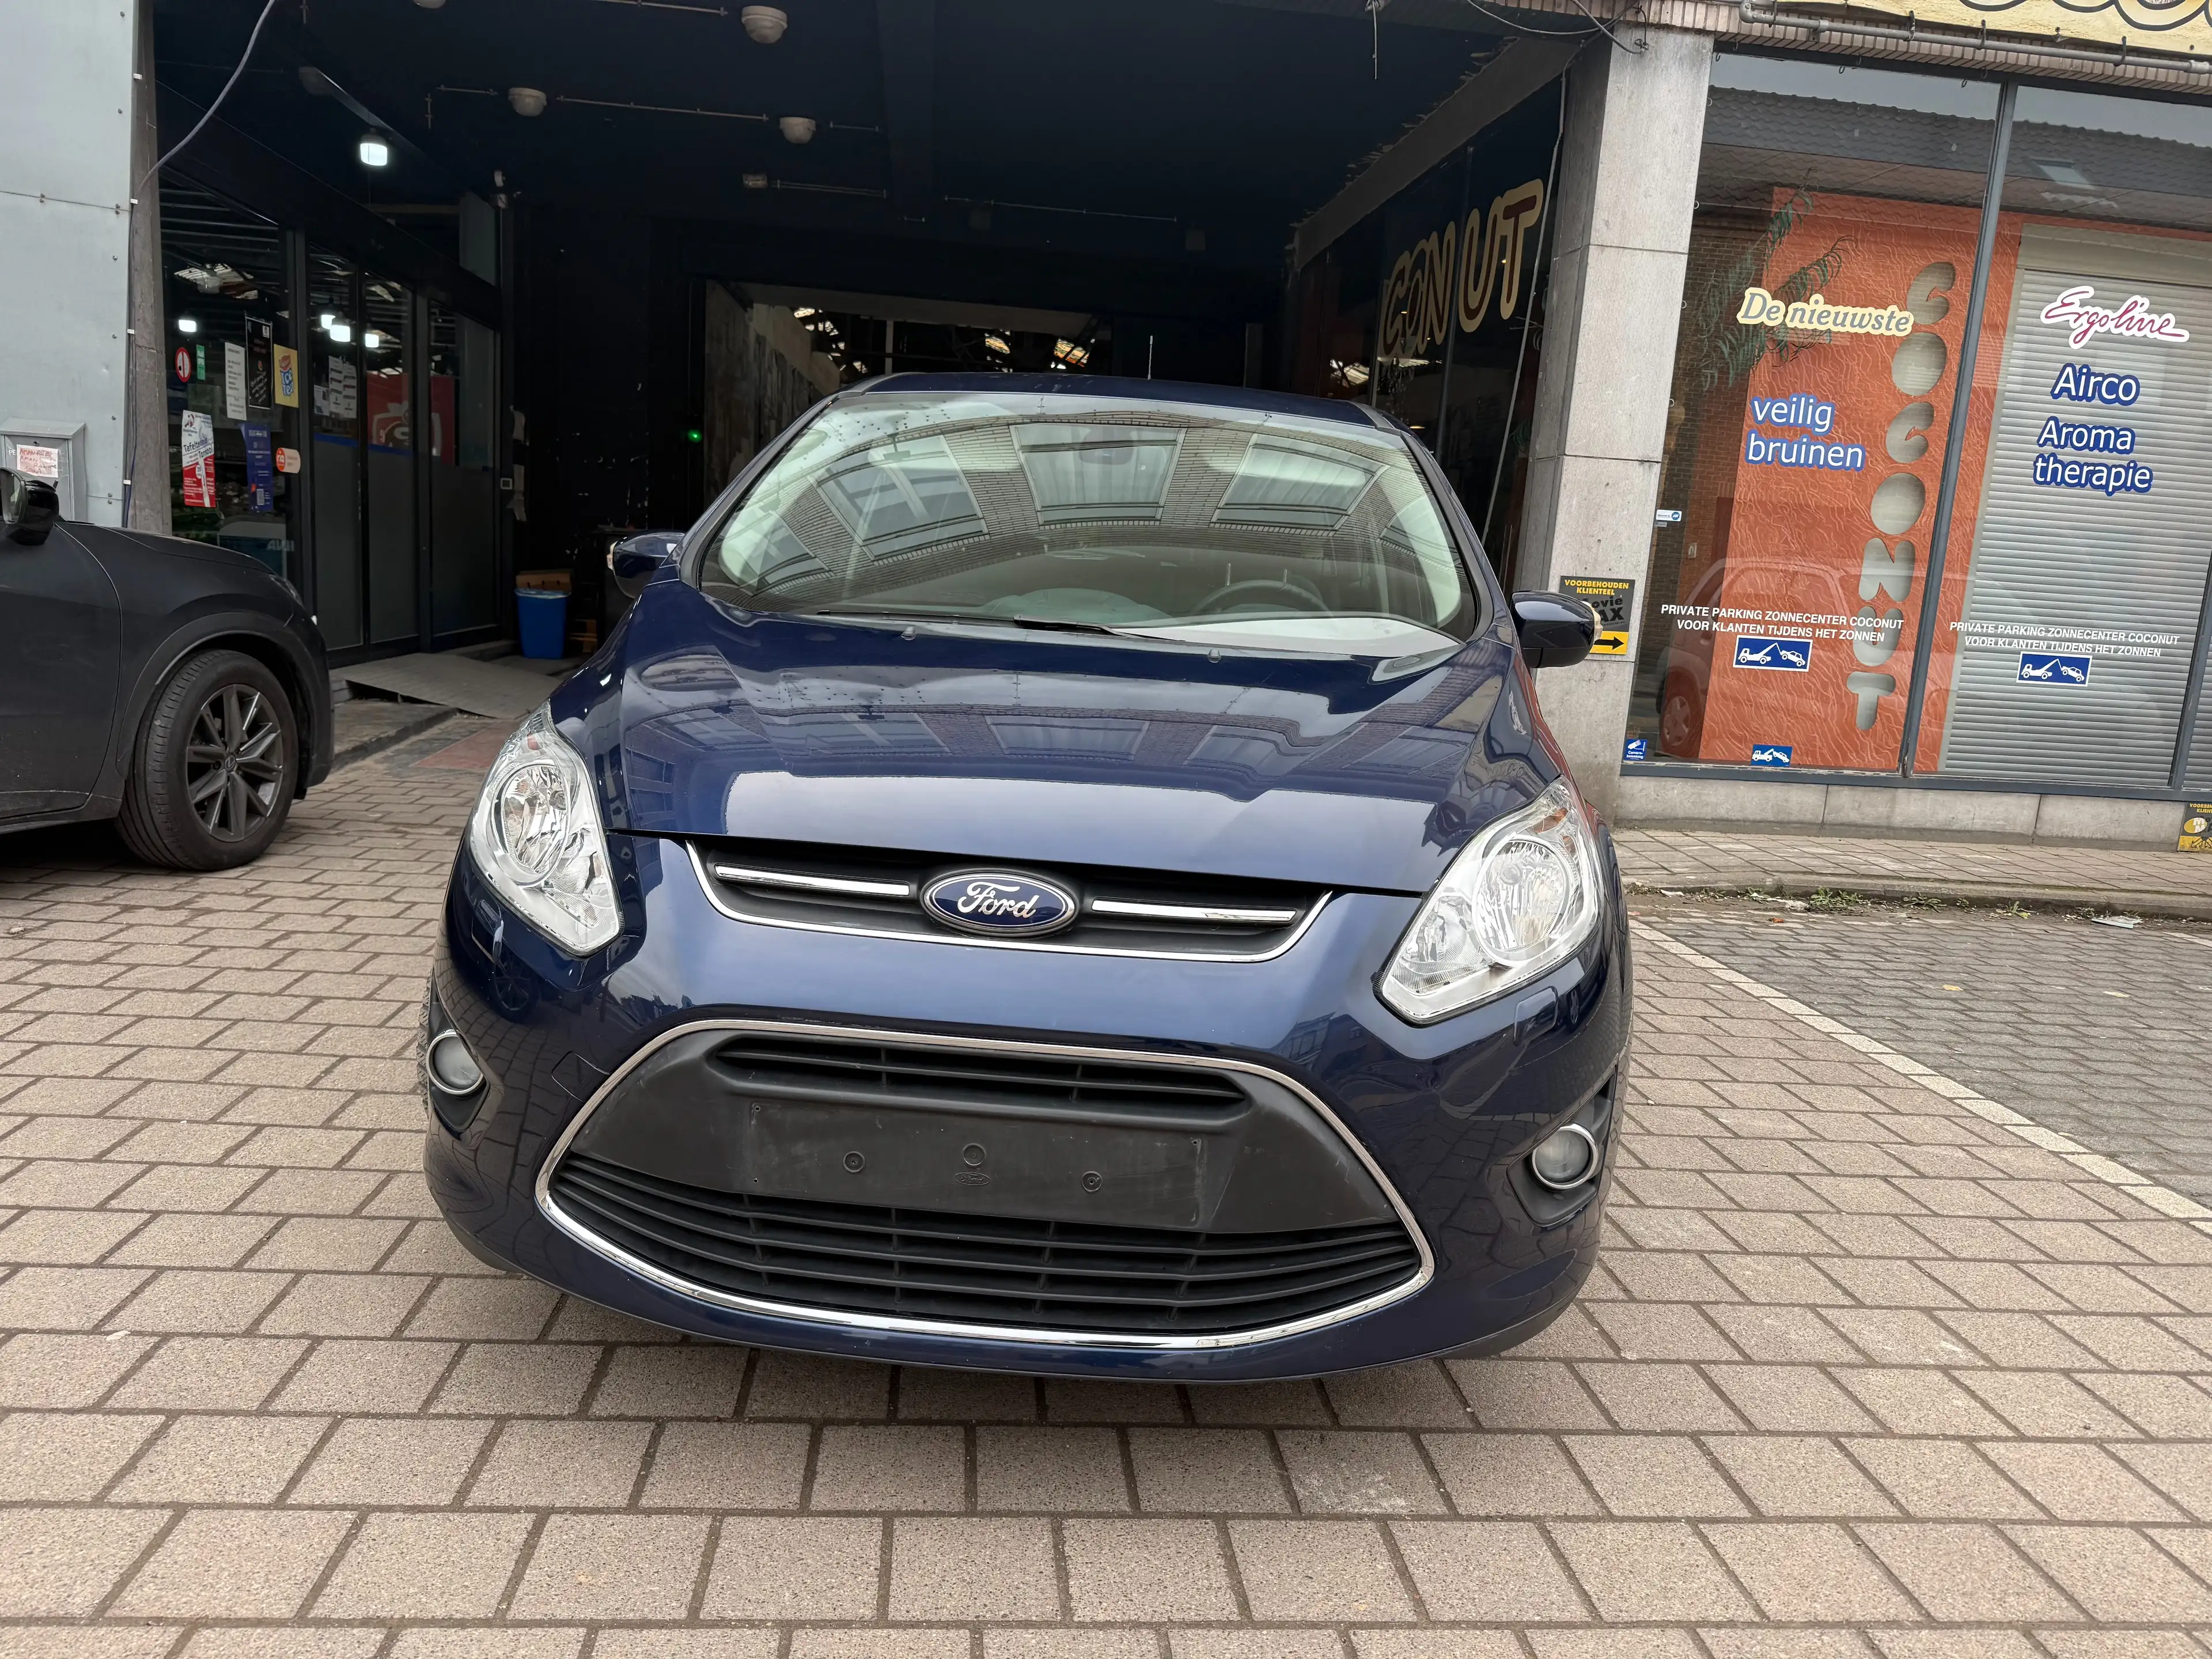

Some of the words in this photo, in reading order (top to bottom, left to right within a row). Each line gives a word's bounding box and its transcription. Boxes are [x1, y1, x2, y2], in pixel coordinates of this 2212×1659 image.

[1741, 292, 1781, 321] De
[1789, 299, 1911, 333] nieuwste
[2045, 290, 2185, 344] Ergoline
[2054, 366, 2137, 402] Airco
[1753, 397, 1832, 433] veilig
[1748, 433, 1863, 468] bruinen
[2039, 420, 2133, 450] Aroma
[2035, 456, 2150, 492] therapie
[1565, 579, 1629, 589] VOORBEHOUDEN
[1577, 587, 1615, 596] KLIENTEEL
[1661, 604, 1710, 616] PRIVATE
[1712, 608, 1763, 620] PARKING
[1764, 611, 1847, 626] ZONNECENTER
[1849, 616, 1904, 630] COCONUT
[1677, 619, 1709, 631] VOOR
[1712, 622, 1764, 634] KLANTEN
[1767, 625, 1813, 638] TIJDENS
[1815, 628, 1838, 639] HET
[1839, 630, 1885, 642] ZONNEN
[1950, 622, 1995, 634] PRIVATE
[1998, 624, 2045, 637] PARKING
[2047, 627, 2126, 642] ZONNECENTER
[2128, 632, 2180, 645] COCONUT
[1964, 635, 1995, 646] VOOR
[1997, 638, 2047, 650] KLANTEN
[2050, 642, 2093, 654] TIJDENS
[2095, 645, 2118, 654] HET
[2118, 646, 2161, 657] ZONNEN
[957, 881, 1040, 918] Ford
